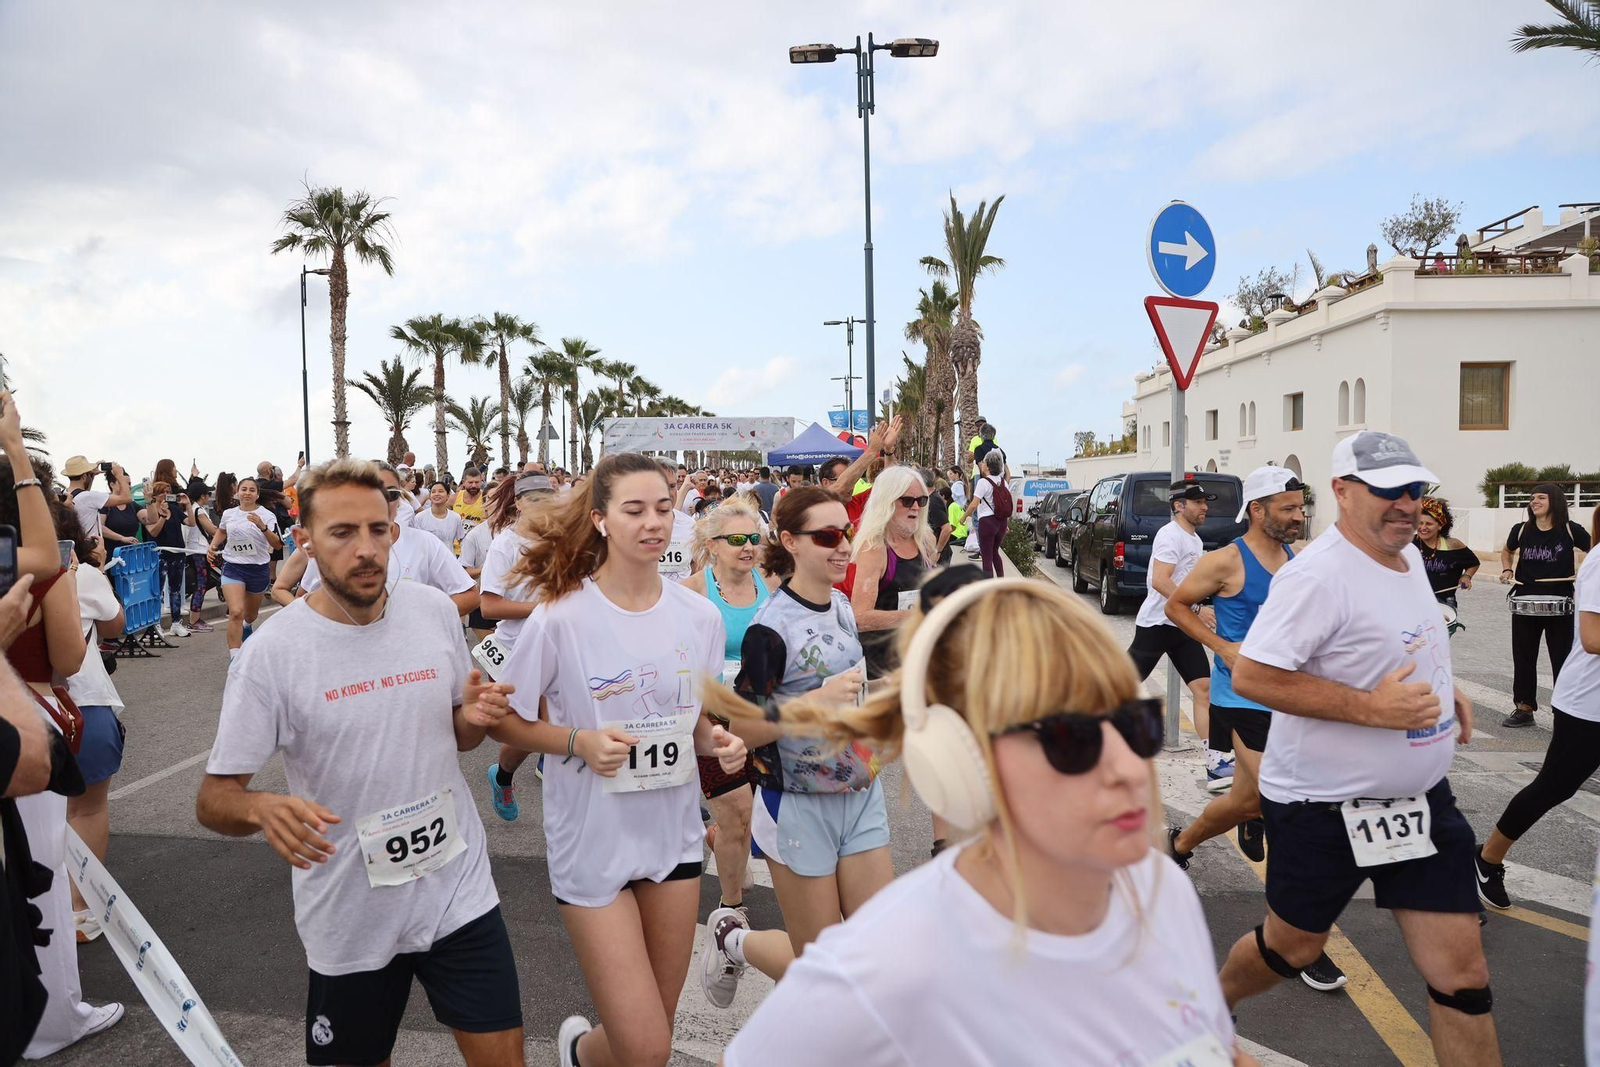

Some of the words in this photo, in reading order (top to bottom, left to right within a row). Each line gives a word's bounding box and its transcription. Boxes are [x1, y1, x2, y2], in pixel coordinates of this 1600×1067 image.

[664, 422, 675, 430] 3A
[677, 422, 719, 430] CARRERA
[721, 422, 732, 430] 5K
[232, 543, 254, 552] 1311
[481, 639, 505, 666] 963
[324, 688, 340, 702] NO
[381, 676, 394, 689] NO
[635, 721, 669, 730] CARRERA
[628, 741, 679, 770] 119
[380, 813, 393, 821] 3A
[393, 800, 430, 818] CARRERA
[430, 795, 438, 803] 5K
[385, 816, 447, 863] 952
[1356, 810, 1425, 844] 1137
